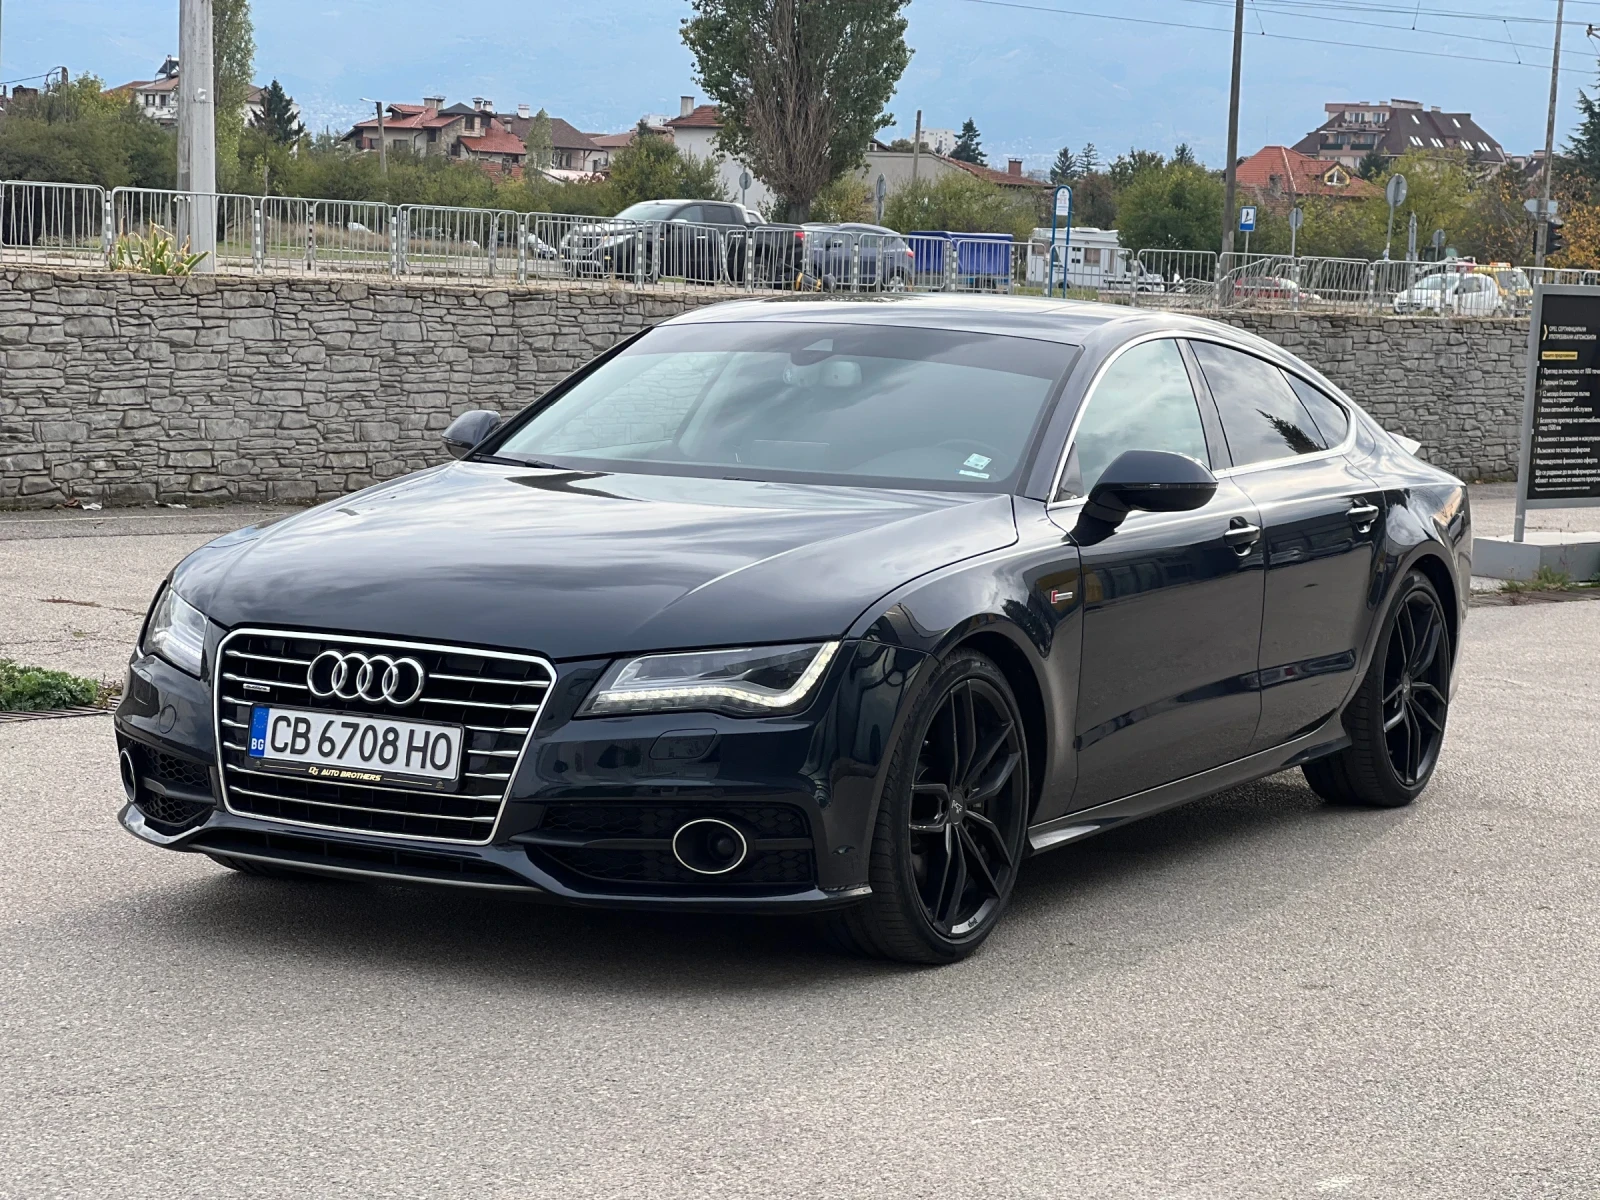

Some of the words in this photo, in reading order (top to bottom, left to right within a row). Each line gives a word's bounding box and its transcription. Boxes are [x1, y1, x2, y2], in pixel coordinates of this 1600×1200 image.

[251, 738, 264, 750] BG
[270, 715, 311, 755] CB
[317, 719, 399, 765] 6708
[405, 729, 452, 771] HO
[321, 769, 340, 777] AUTO
[340, 771, 382, 782] BROTHERS
